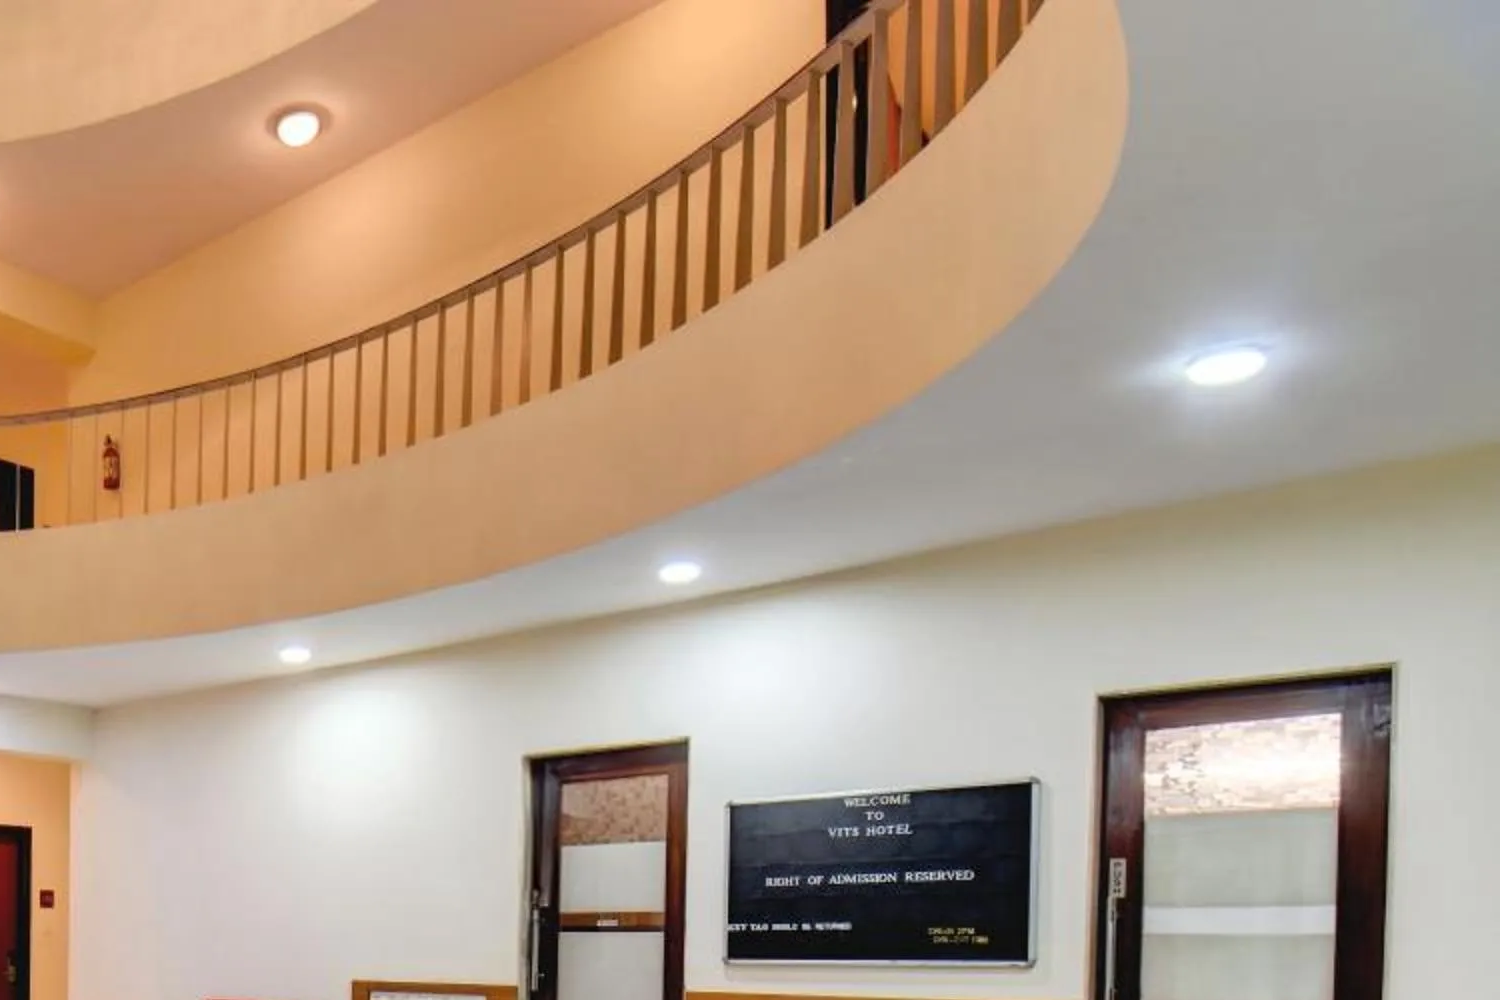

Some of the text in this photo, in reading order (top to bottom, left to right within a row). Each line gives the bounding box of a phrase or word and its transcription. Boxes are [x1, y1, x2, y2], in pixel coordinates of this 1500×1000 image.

[843, 794, 911, 808] WELCOME
[864, 811, 885, 821] TO
[827, 823, 913, 838] VITS HOTEL
[765, 869, 975, 888] RIGHT OF ADMISSION RESERVED
